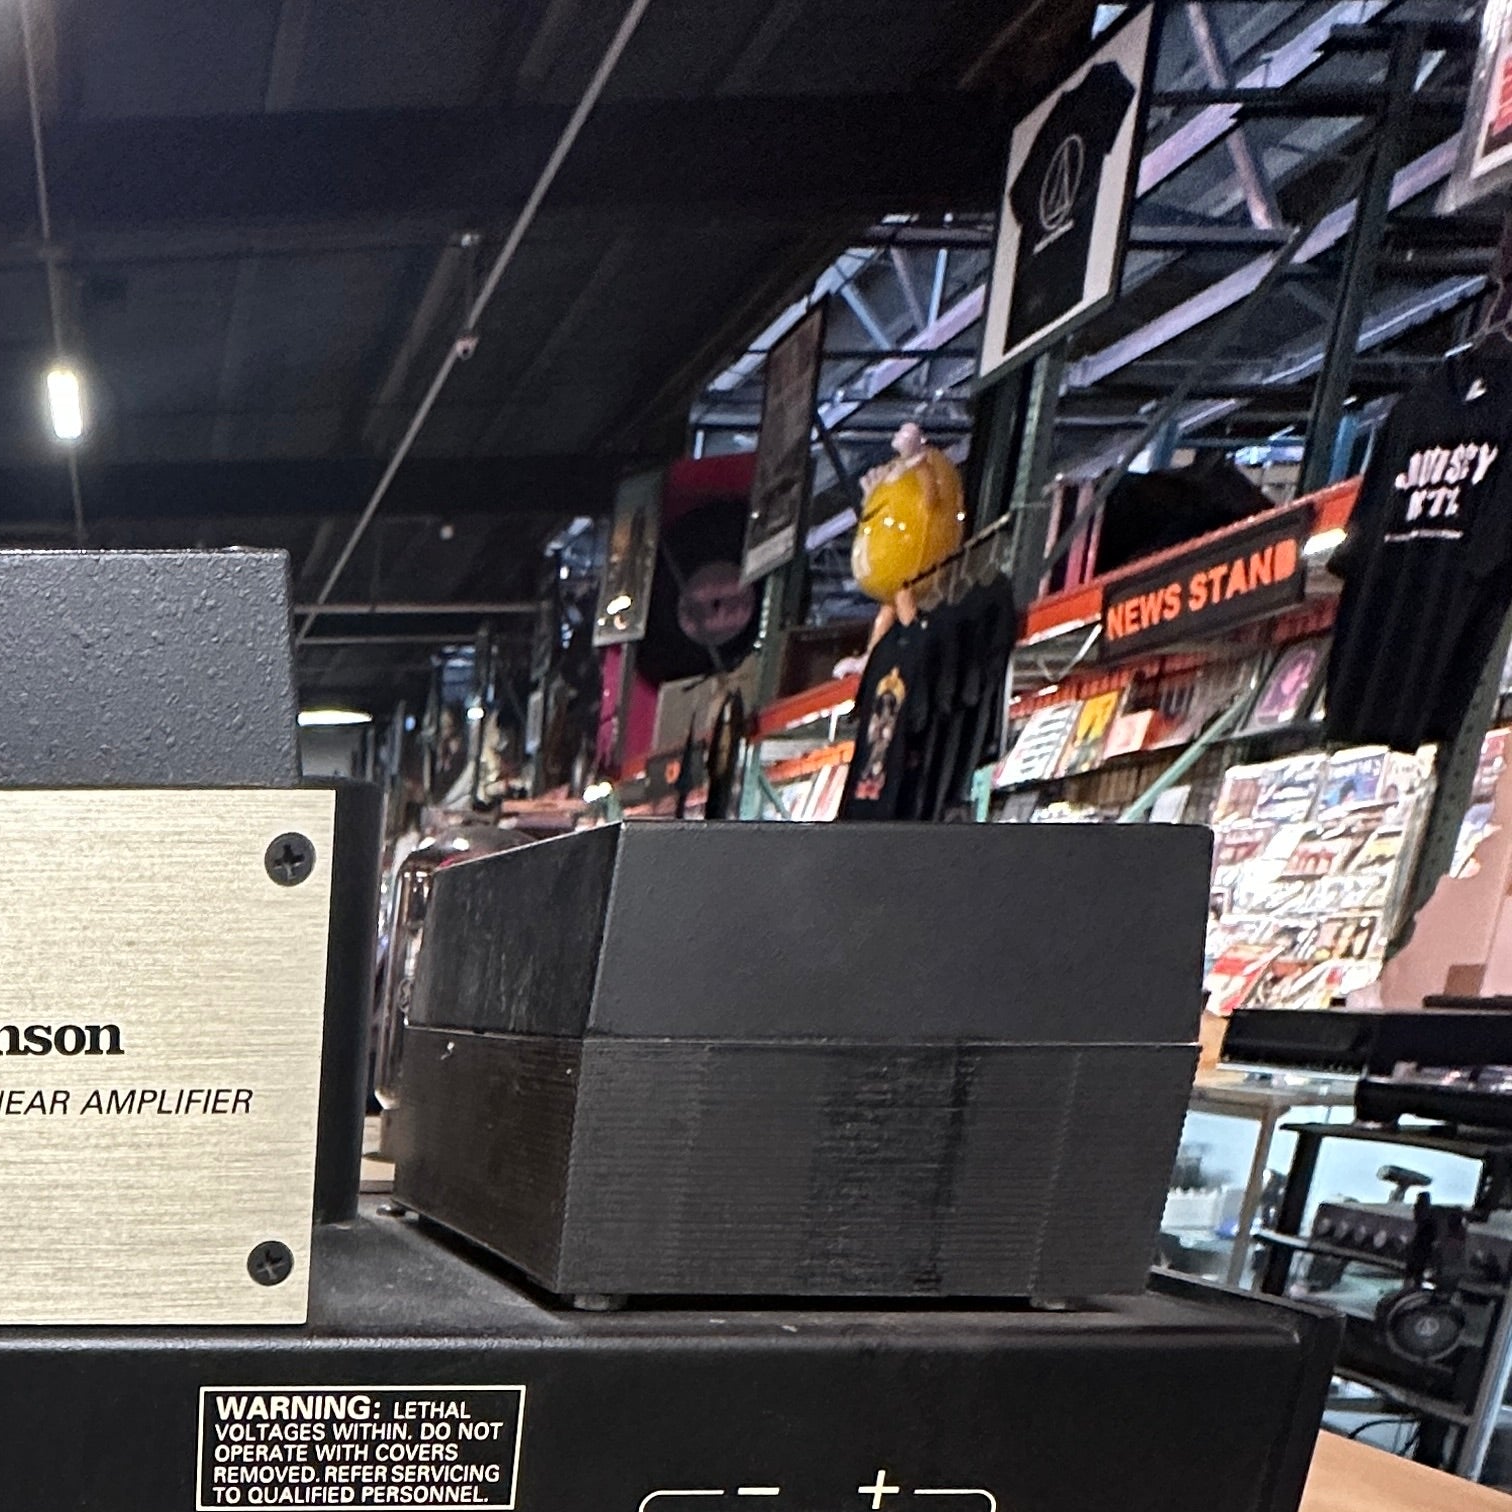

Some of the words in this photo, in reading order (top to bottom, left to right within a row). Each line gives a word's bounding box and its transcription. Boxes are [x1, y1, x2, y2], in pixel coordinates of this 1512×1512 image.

[1106, 583, 1182, 641] NEWS
[1188, 538, 1297, 612] STAND
[80, 1089, 254, 1114] AMPLIFIER
[215, 1395, 381, 1421] WARNING:
[393, 1400, 471, 1420] LETHAL
[214, 1422, 326, 1442] VOLTAGES
[332, 1422, 413, 1441] WITHIN.
[420, 1421, 451, 1441] DO
[458, 1421, 504, 1441] NOT
[214, 1444, 308, 1463] OPERATE
[315, 1444, 369, 1462] WITH
[375, 1443, 459, 1462] COVERS
[213, 1465, 320, 1484] REMOVED.
[324, 1465, 388, 1483] REFER
[390, 1464, 500, 1483] SERVICING
[212, 1486, 241, 1504] TO
[247, 1486, 355, 1504] QUALIFIED
[361, 1485, 489, 1504] PERSONNEL.
